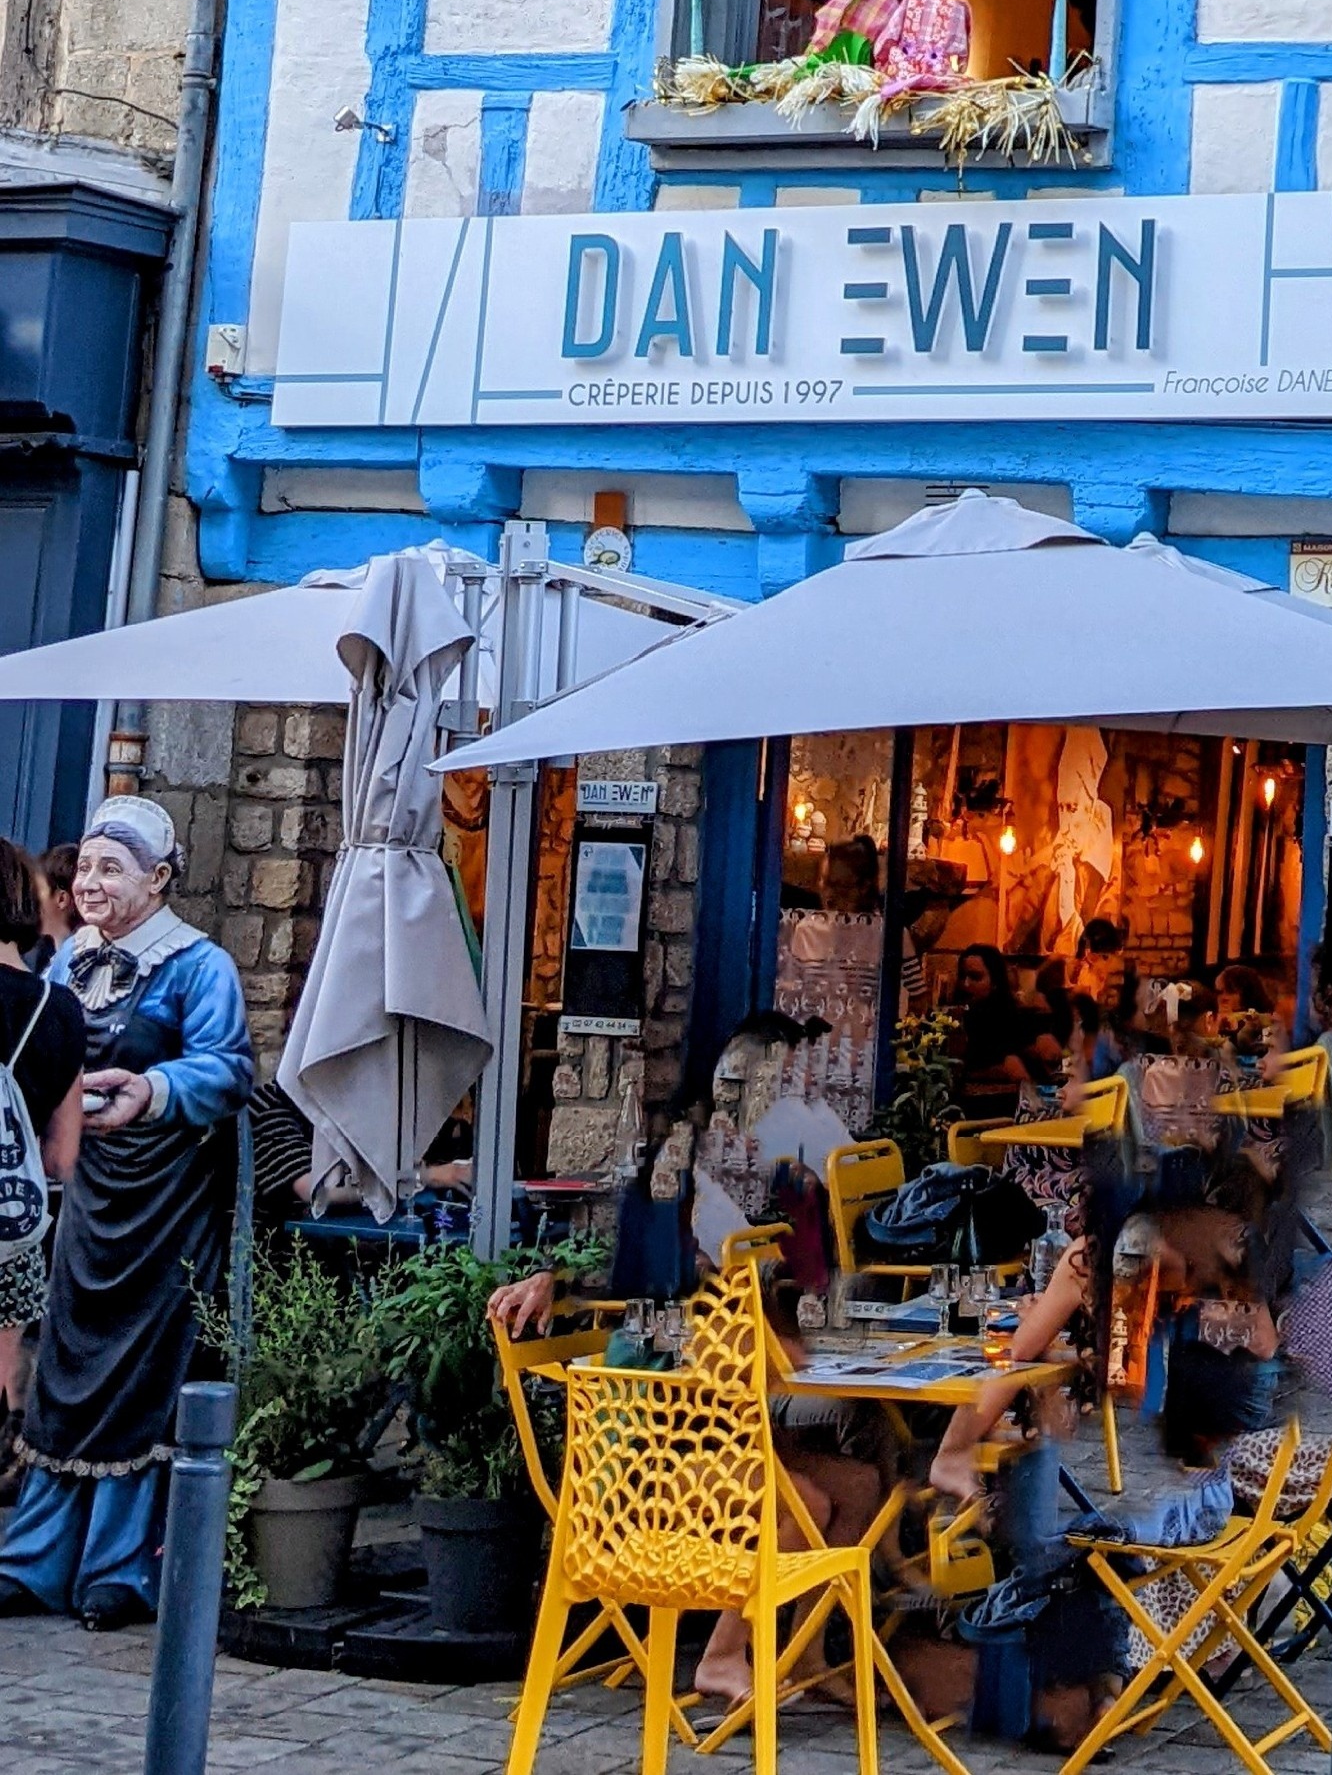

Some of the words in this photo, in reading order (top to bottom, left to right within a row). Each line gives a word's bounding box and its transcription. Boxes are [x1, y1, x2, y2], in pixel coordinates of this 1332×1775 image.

[561, 228, 779, 359] DAN
[840, 218, 1156, 353] EWEN
[567, 378, 680, 407] CRÊPERIE
[690, 381, 773, 405] DEPUIS
[782, 379, 843, 405] 1997
[1163, 370, 1268, 398] Françoise
[583, 784, 607, 800] DAN
[611, 784, 649, 802] EWEN
